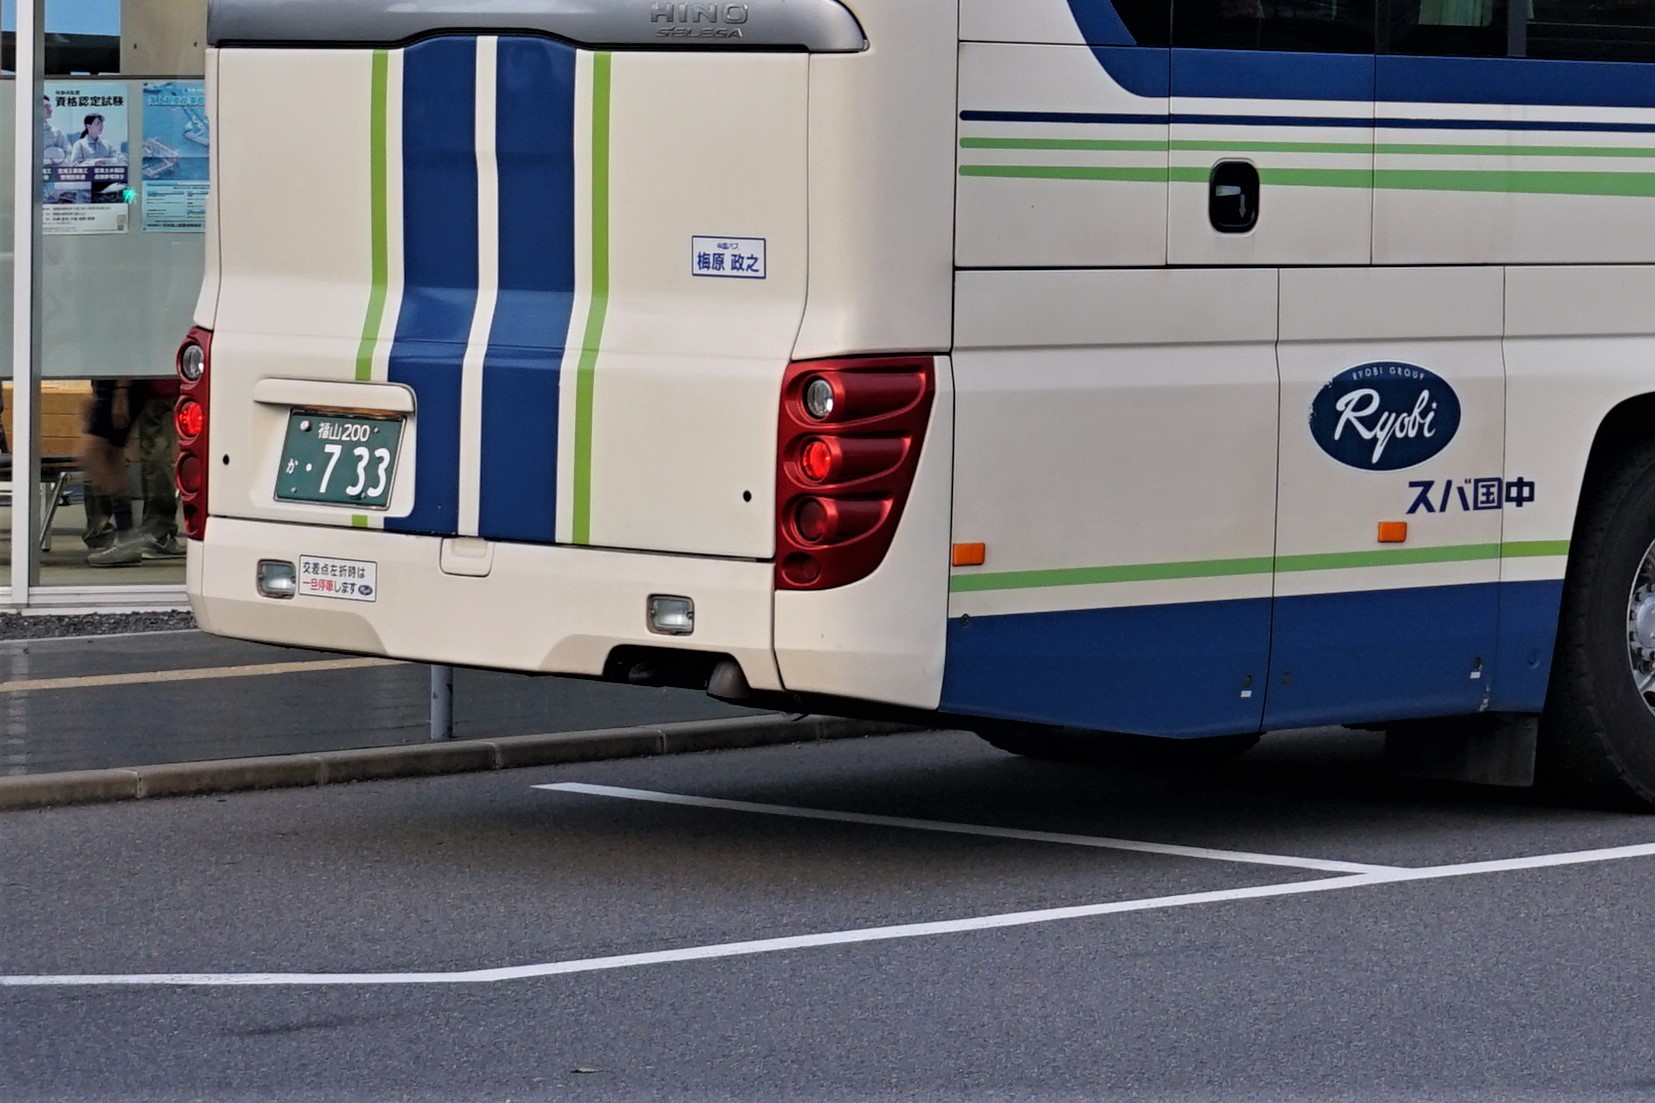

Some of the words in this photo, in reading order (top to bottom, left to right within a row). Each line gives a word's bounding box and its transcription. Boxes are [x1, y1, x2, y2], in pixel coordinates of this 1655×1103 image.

[650, 2, 748, 24] HINO
[656, 26, 743, 38] SELEGA
[56, 96, 124, 107] 資格認定試験
[1334, 388, 1437, 464] Ryobi
